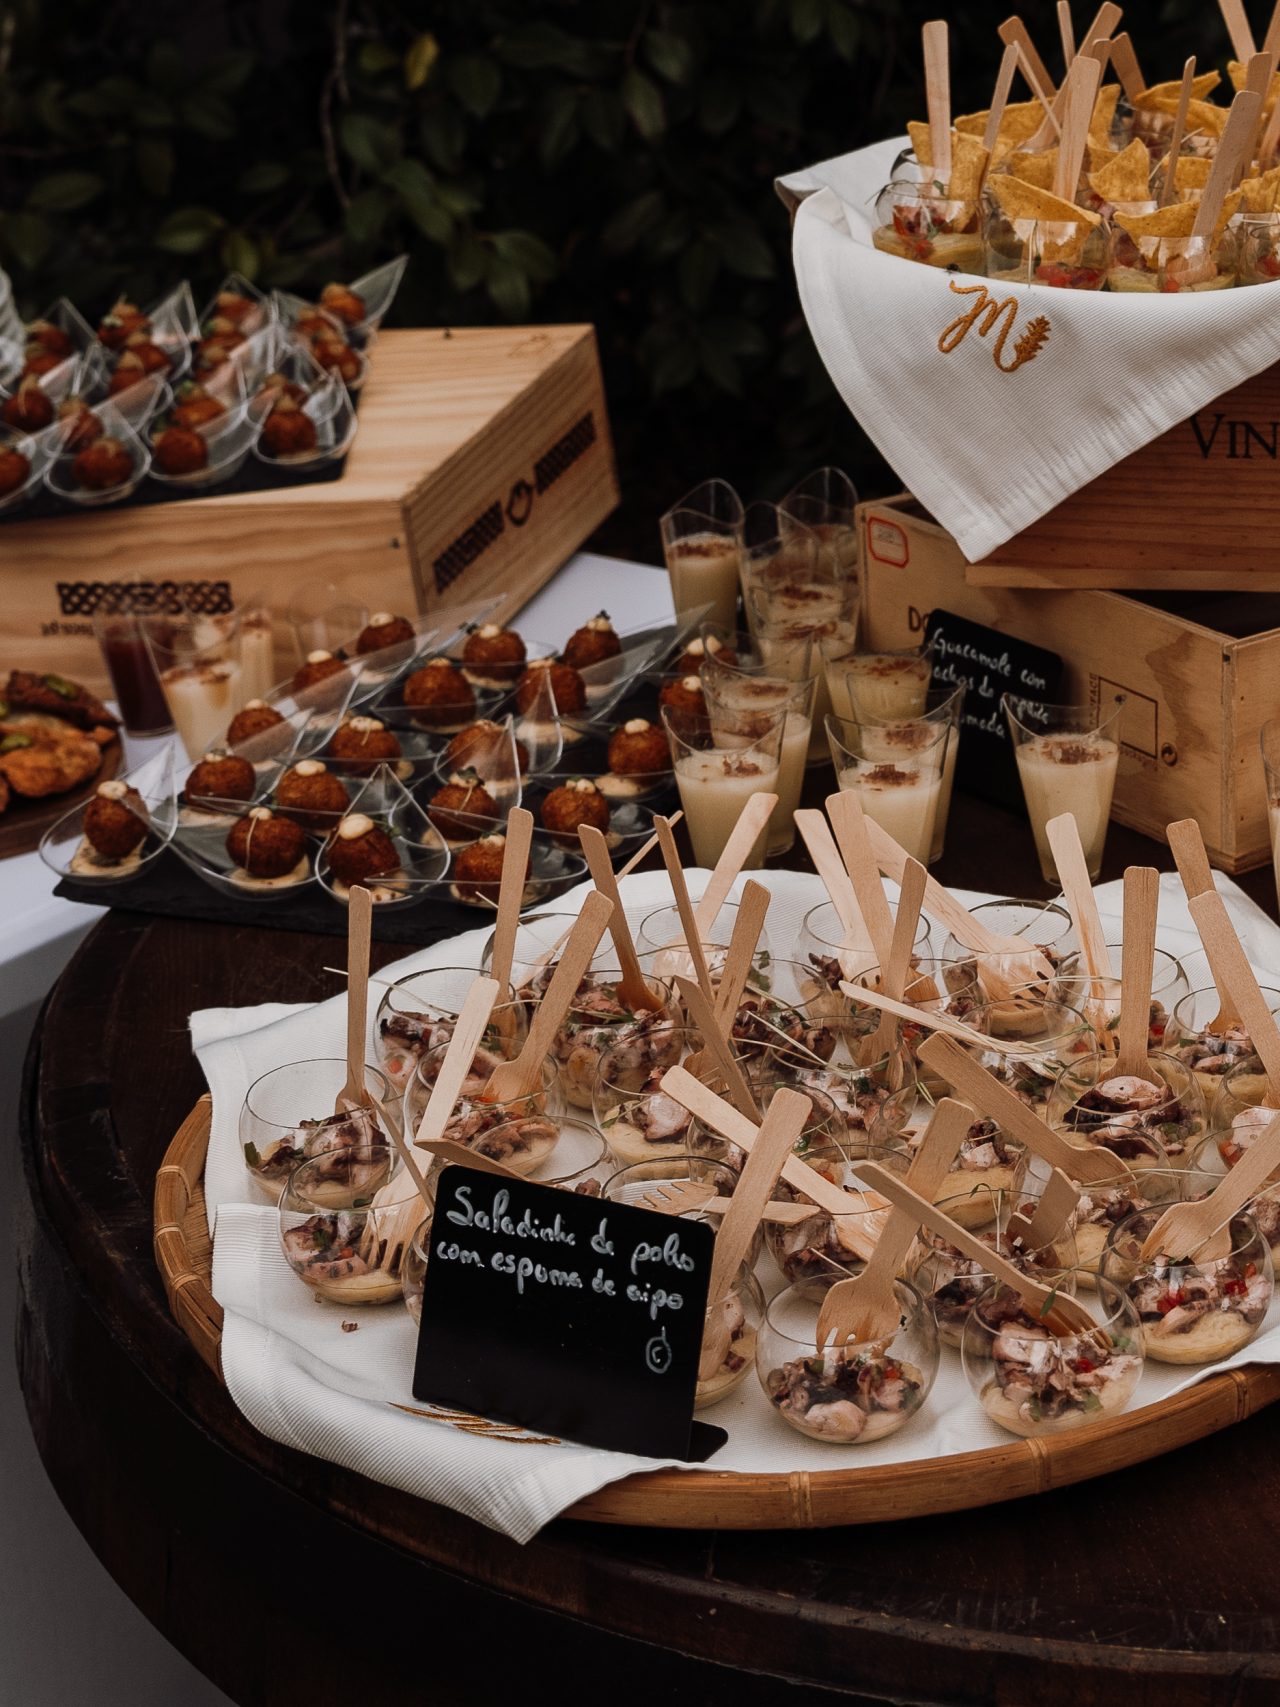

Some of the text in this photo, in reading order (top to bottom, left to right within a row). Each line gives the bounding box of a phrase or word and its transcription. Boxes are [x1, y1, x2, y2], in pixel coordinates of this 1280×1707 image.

[932, 628, 1011, 677] Guacamole
[933, 663, 974, 691] achos
[436, 1241, 485, 1268] com
[491, 1252, 583, 1295] espuma
[592, 1268, 616, 1296] de
